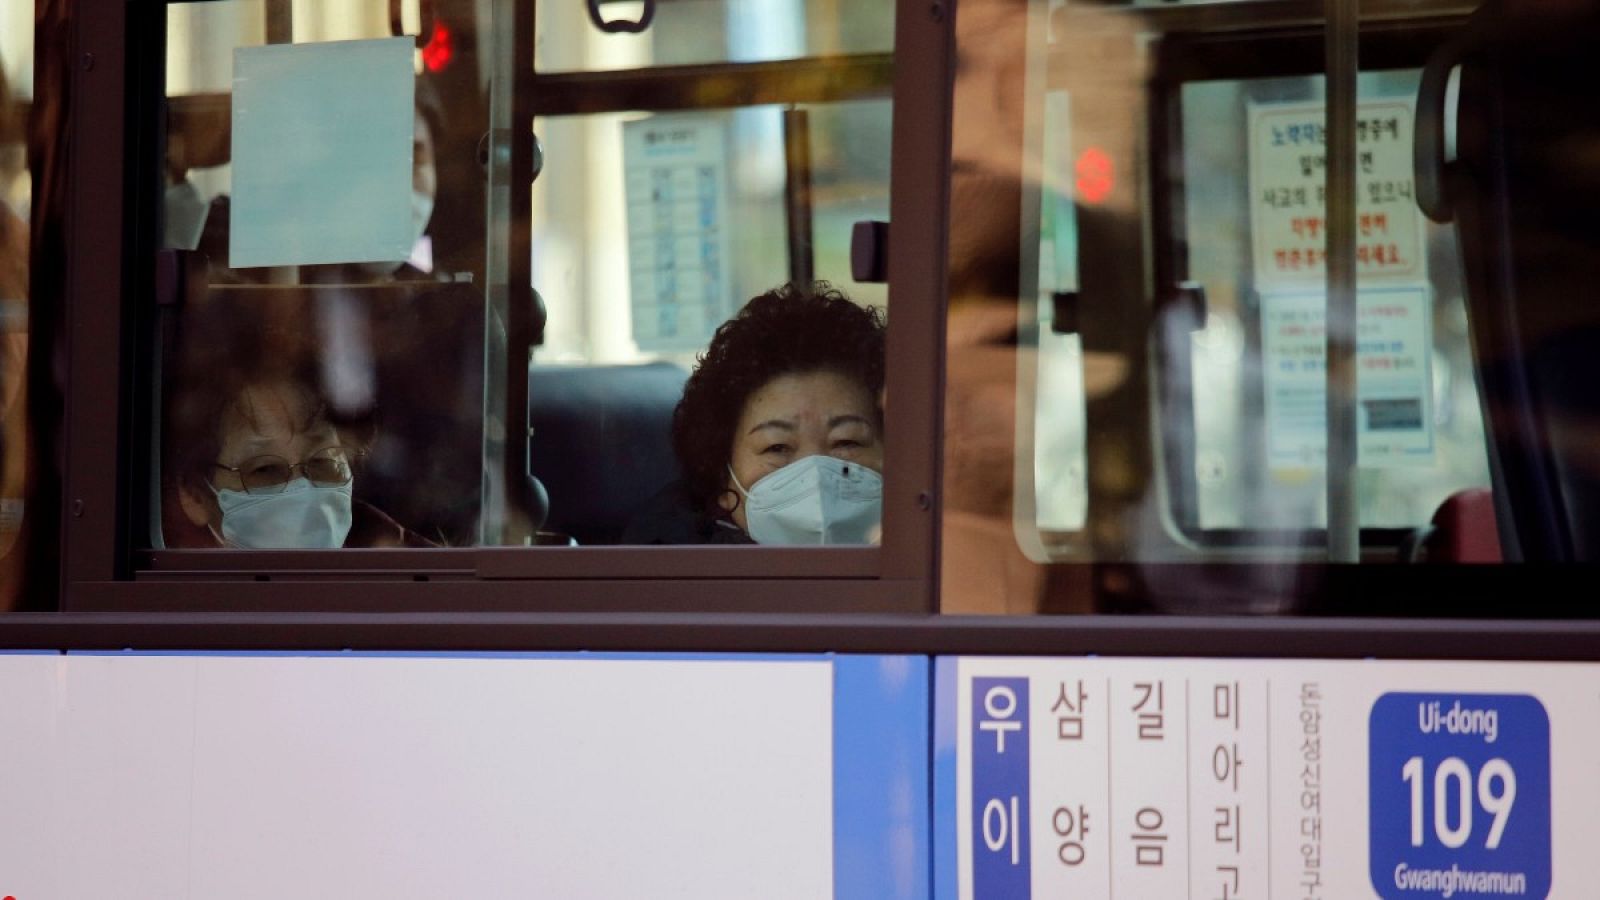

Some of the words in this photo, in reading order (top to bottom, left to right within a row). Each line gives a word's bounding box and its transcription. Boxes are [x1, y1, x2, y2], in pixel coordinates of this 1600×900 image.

[979, 685, 1022, 865] 우이
[1050, 680, 1089, 866] 삼양
[1130, 680, 1168, 866] 길음
[1299, 682, 1322, 900] 돈암성신여대입구
[1402, 756, 1517, 849] 109
[1419, 700, 1498, 743] Ui-dong
[1394, 862, 1526, 898] Gwanghwamun
